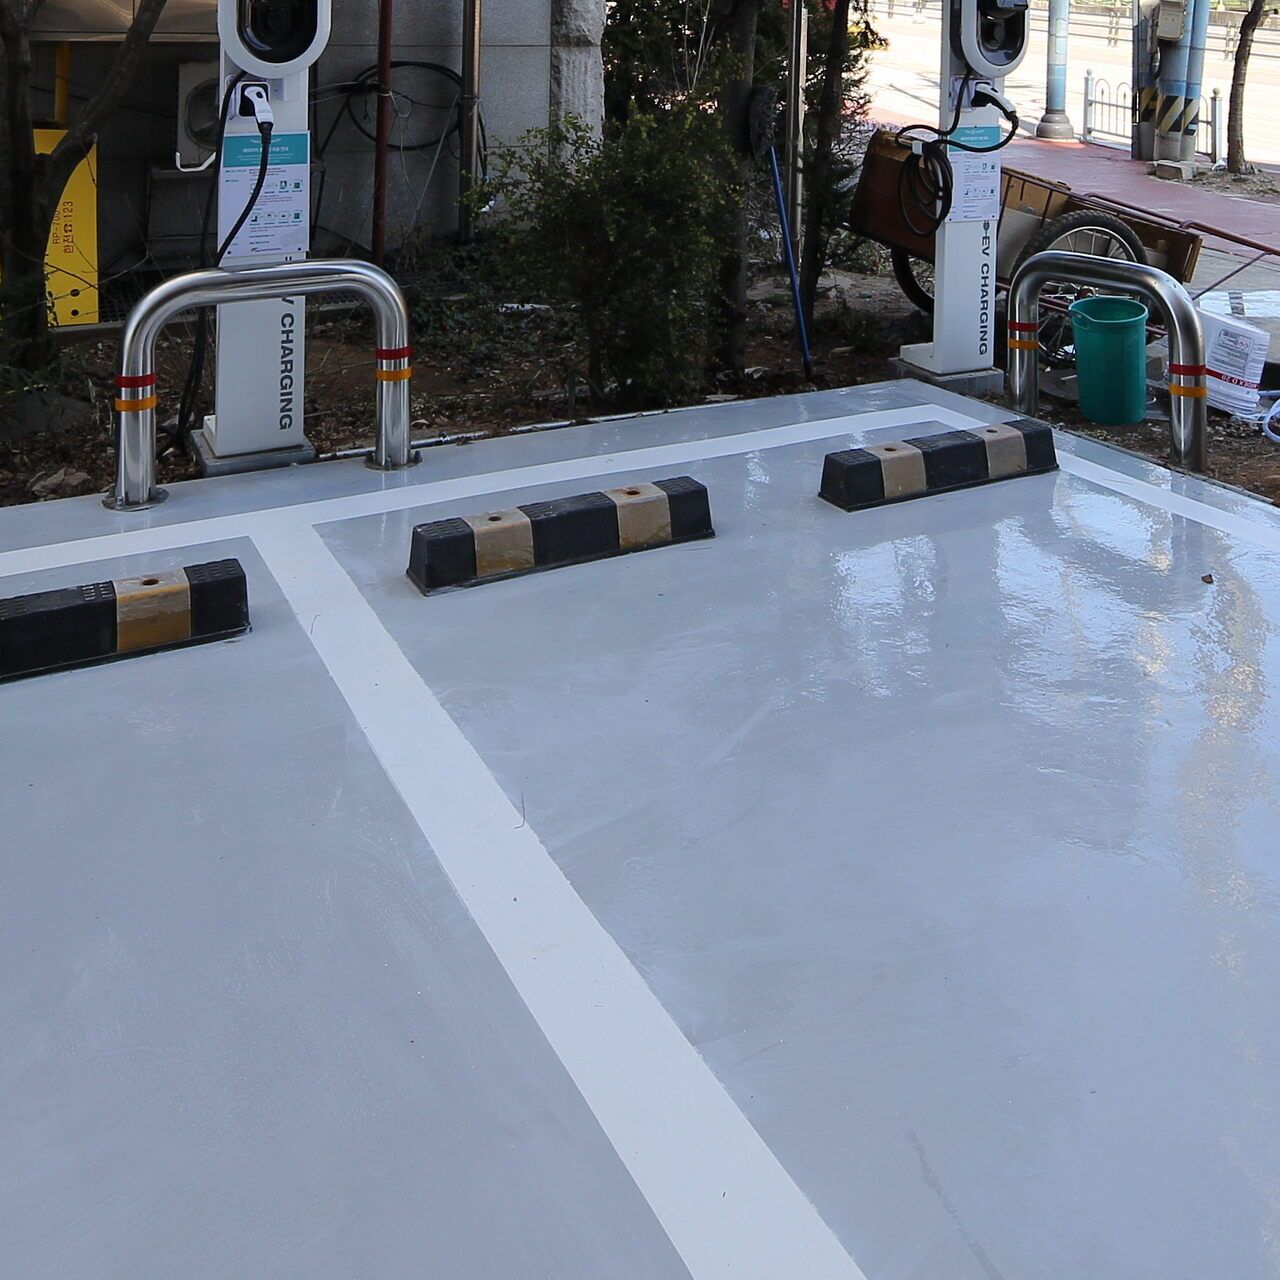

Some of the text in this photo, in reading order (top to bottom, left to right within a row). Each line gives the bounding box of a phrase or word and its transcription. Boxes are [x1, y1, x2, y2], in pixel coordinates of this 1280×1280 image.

[978, 235, 991, 355] EV CHARGING
[279, 313, 295, 430] CHARGING
